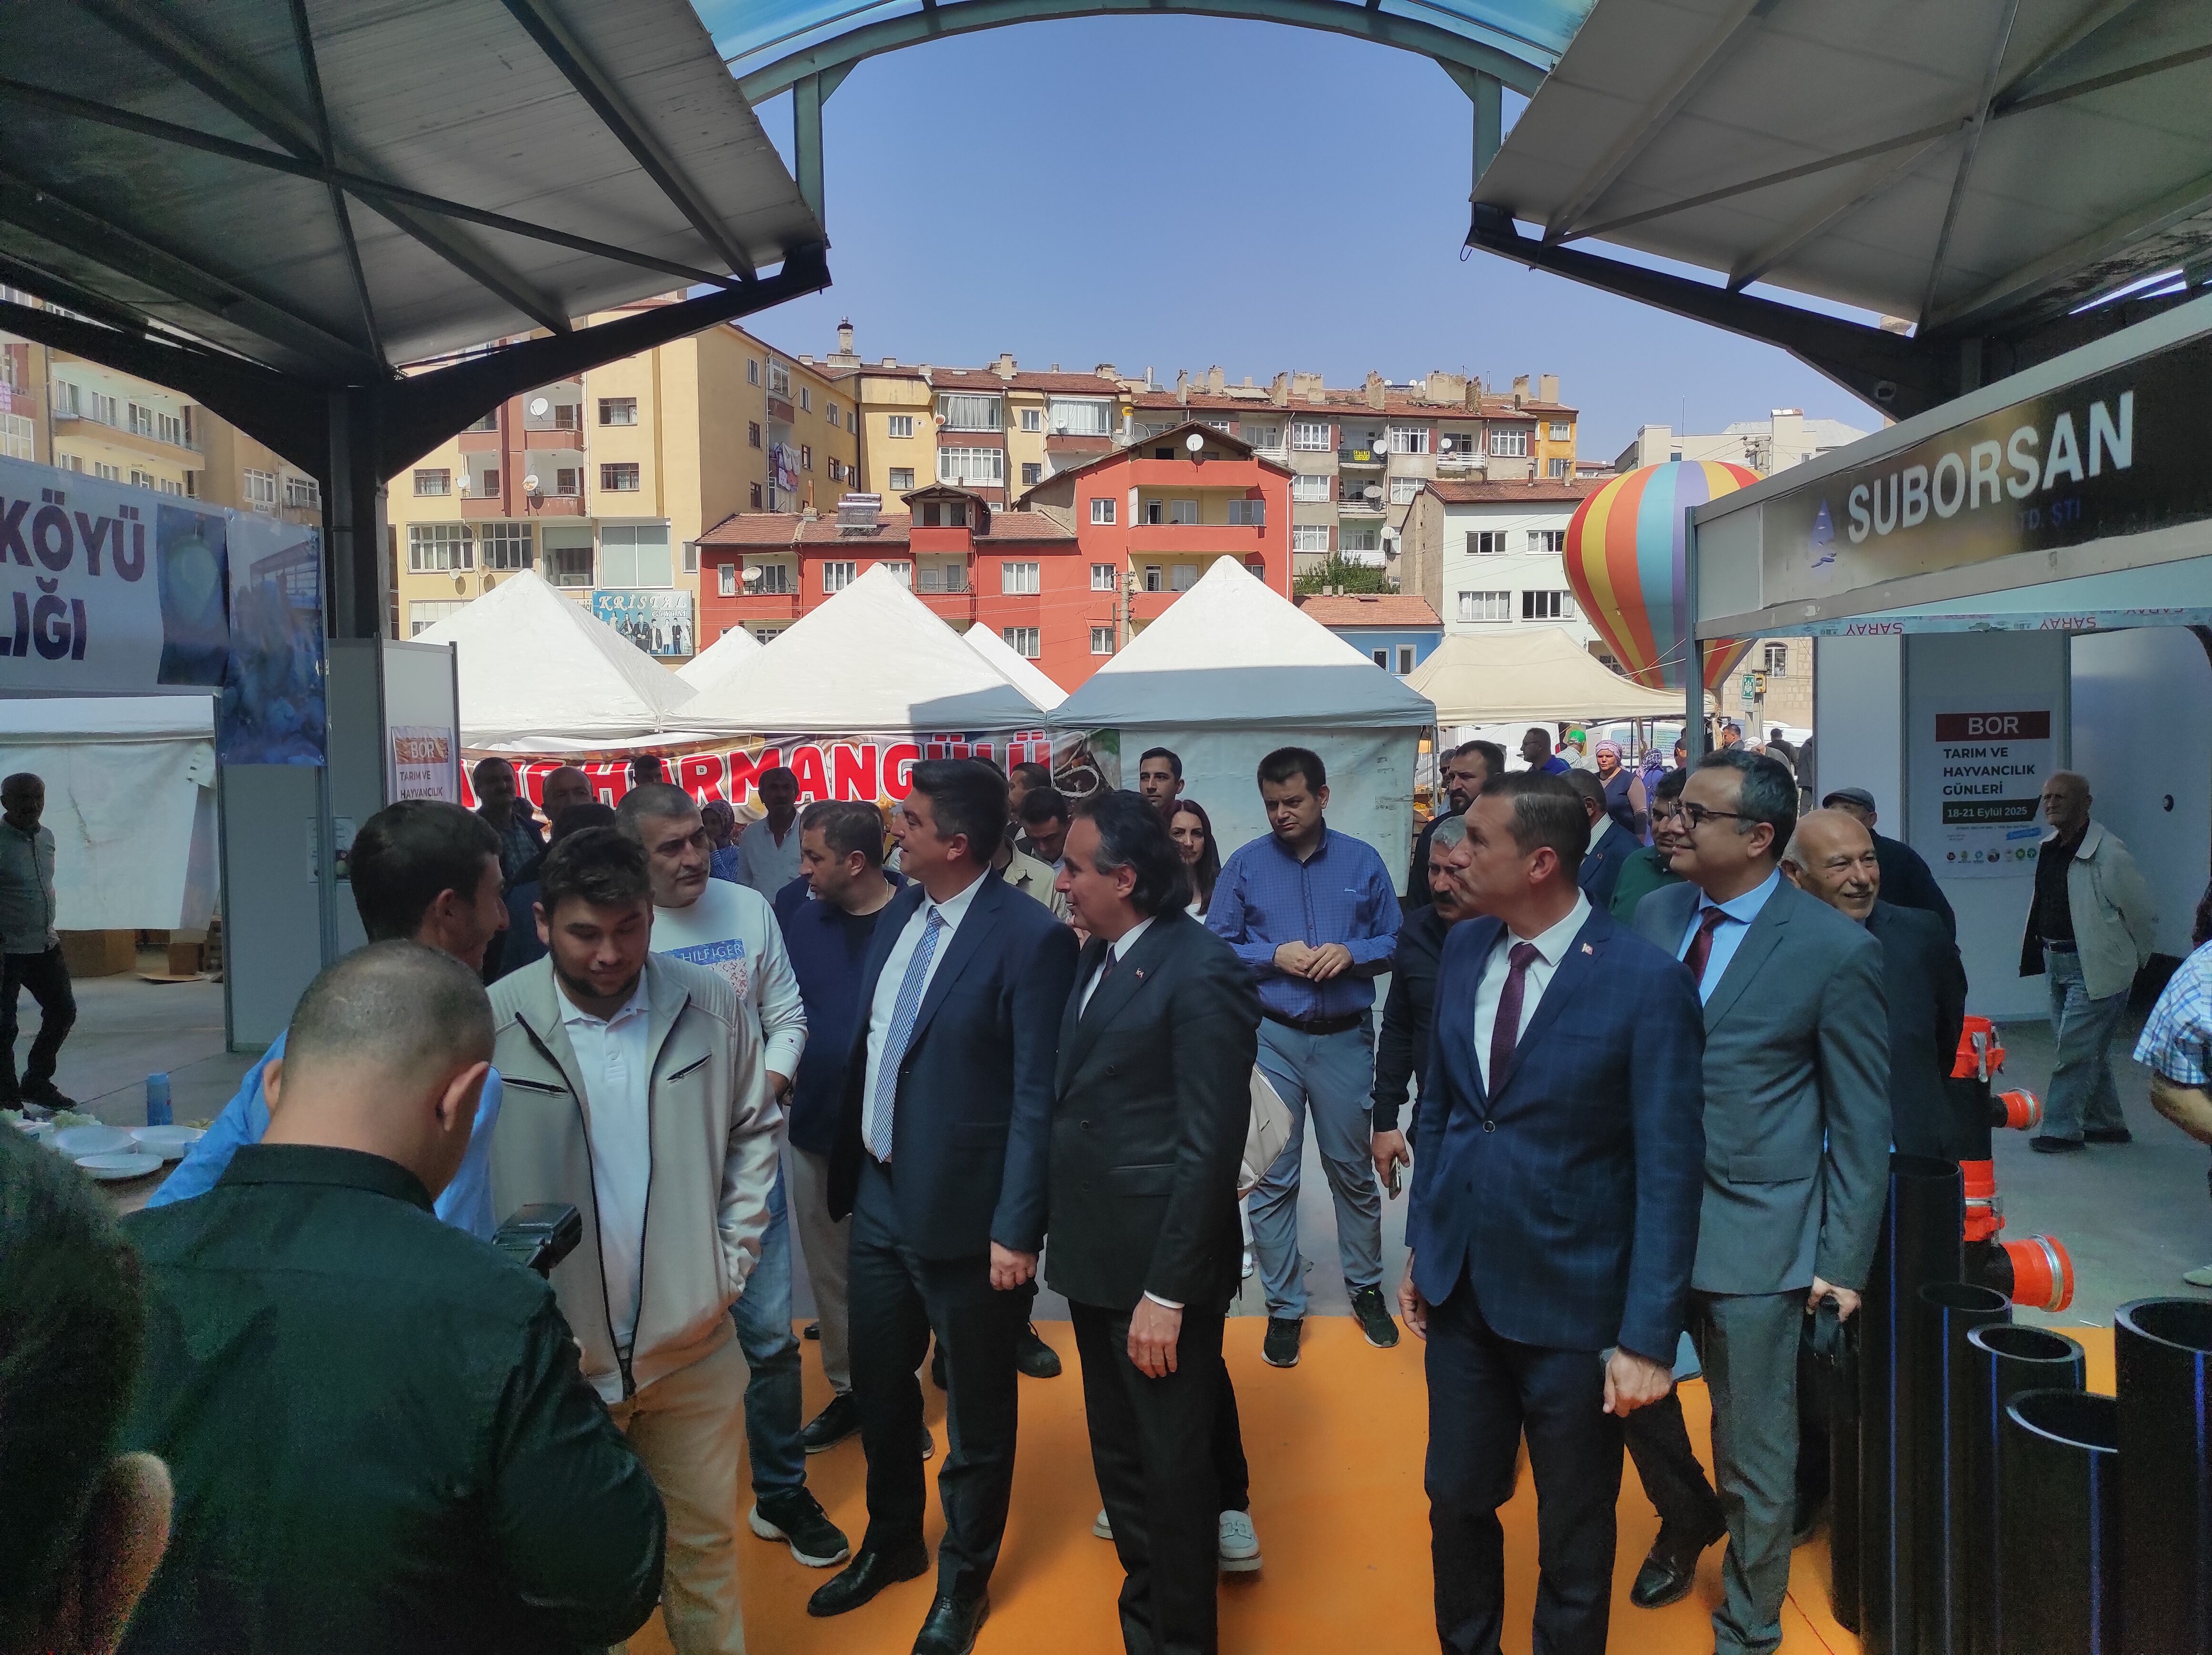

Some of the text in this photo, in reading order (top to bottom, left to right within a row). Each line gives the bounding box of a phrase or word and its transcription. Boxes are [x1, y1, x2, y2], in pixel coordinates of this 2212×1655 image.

[1847, 391, 2134, 544] SUBORSAN
[255, 504, 269, 512] ADA
[0, 488, 145, 582] KÖYÜ
[598, 594, 687, 612] KRİSTAL
[1846, 622, 1905, 635] SARAY
[2039, 617, 2096, 630] SARAY
[1968, 716, 2019, 735] BOR
[411, 741, 434, 758] BOR
[1943, 747, 2008, 759] TARIM VE
[400, 770, 431, 781] TARIM VE
[1943, 765, 2035, 777] HAYVANCILIK
[400, 787, 443, 799] HAYVANCILIK
[1943, 781, 2003, 796] GÜNLERİ
[1947, 807, 2028, 819] 18-21 Eylül 2025
[681, 943, 742, 962] HILFIGER
